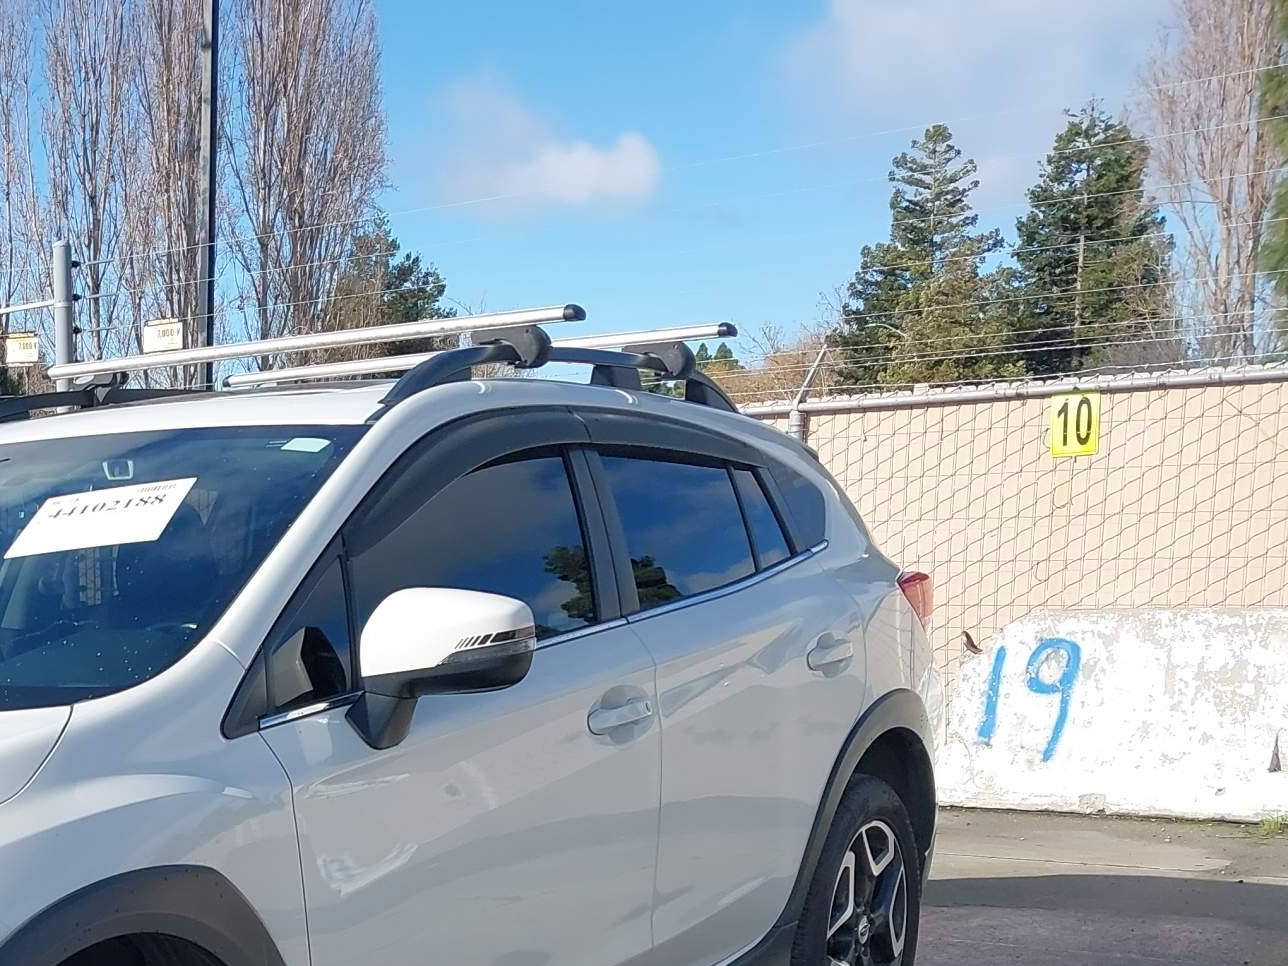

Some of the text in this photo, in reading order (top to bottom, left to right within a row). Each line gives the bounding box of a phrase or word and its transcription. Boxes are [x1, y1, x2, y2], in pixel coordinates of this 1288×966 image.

[1057, 397, 1092, 446] 10
[48, 494, 167, 518] 44102188
[977, 638, 1081, 762] 19
